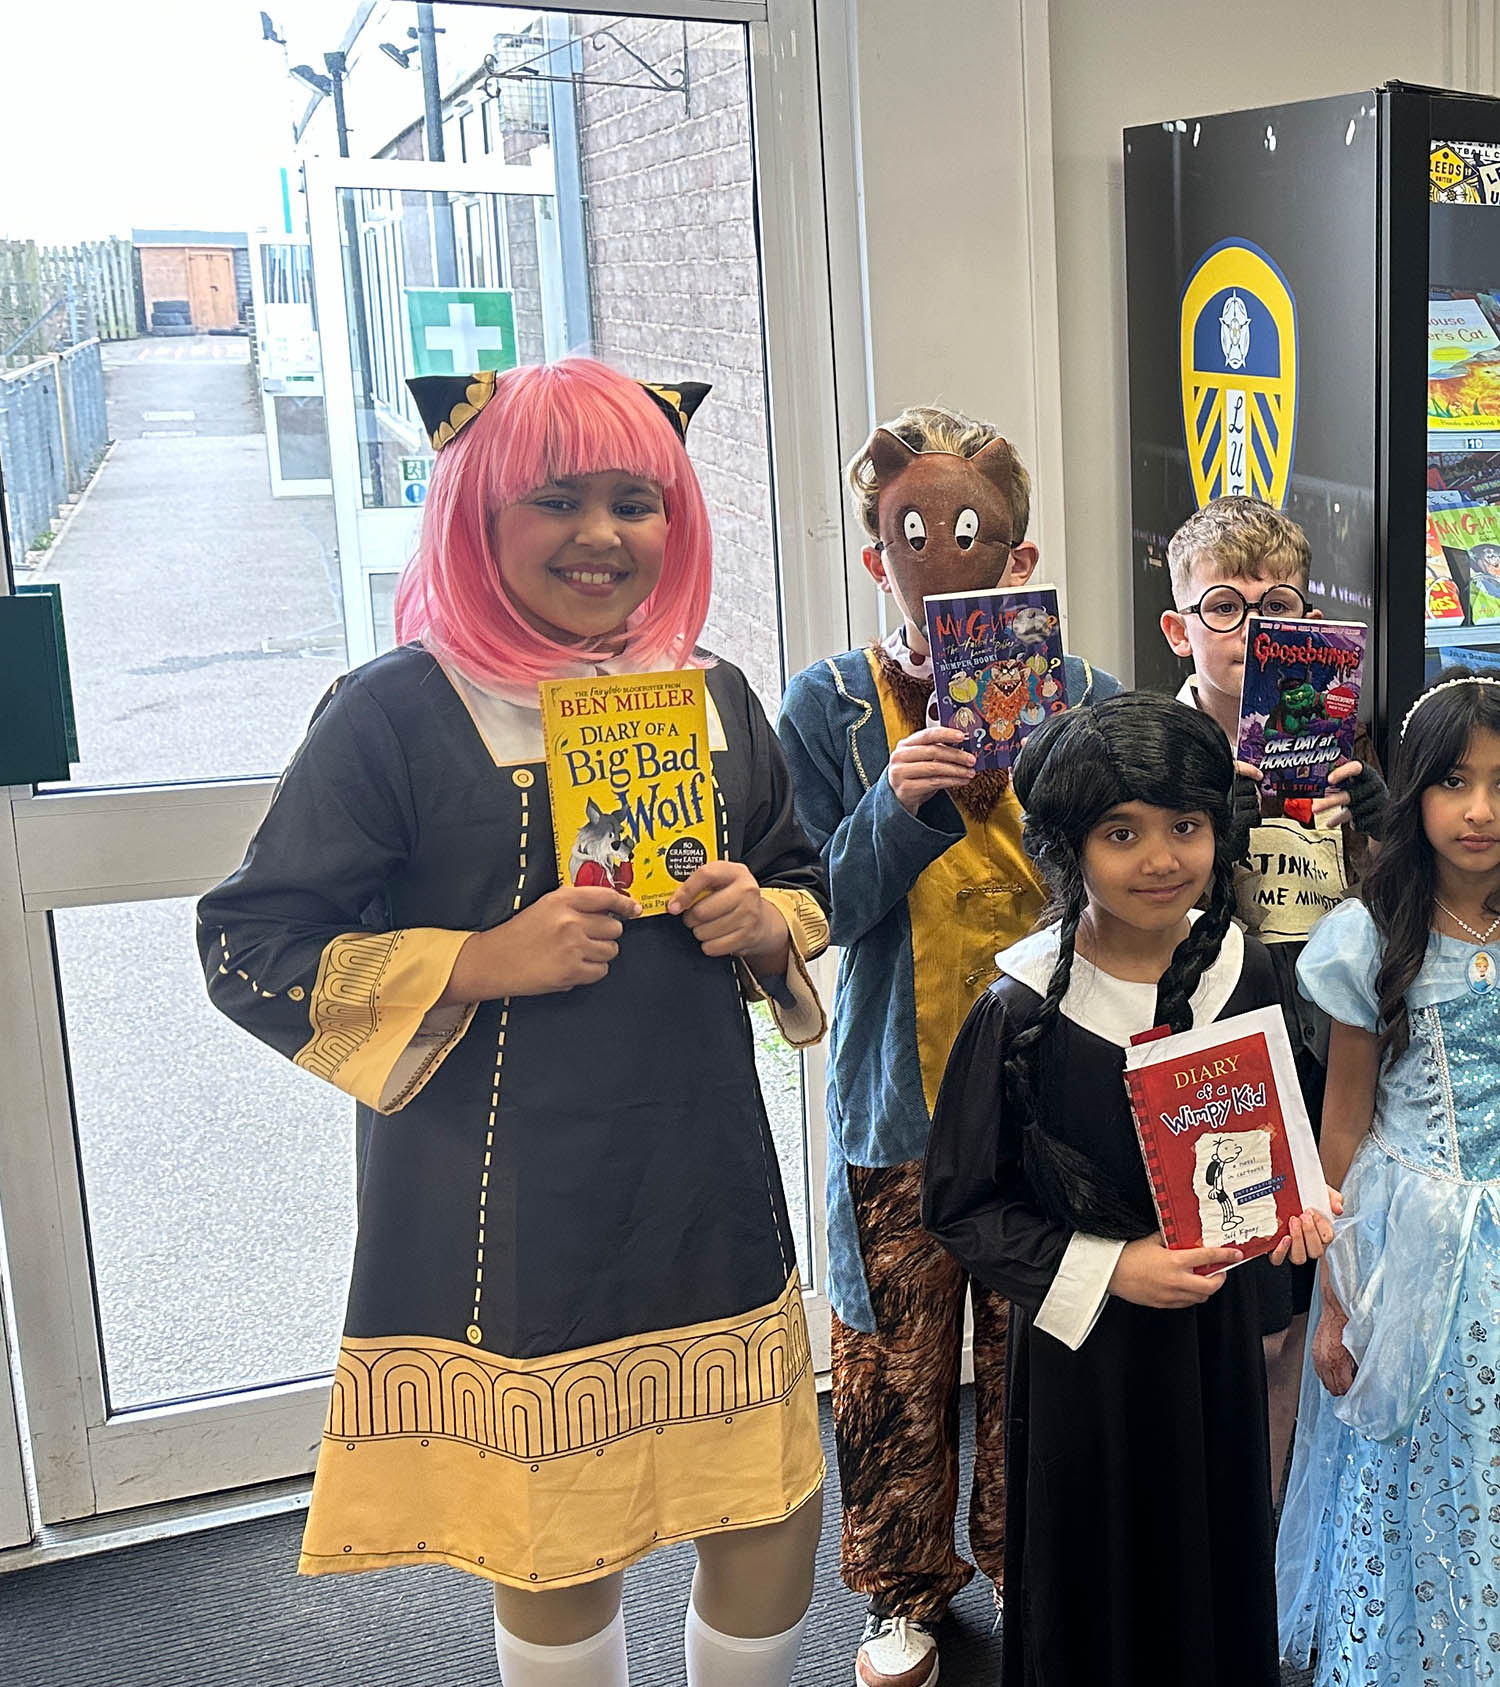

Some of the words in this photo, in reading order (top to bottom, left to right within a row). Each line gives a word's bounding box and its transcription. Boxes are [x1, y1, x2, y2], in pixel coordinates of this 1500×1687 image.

[1430, 161, 1462, 176] EEDS
[1459, 328, 1488, 342] Cat
[1435, 519, 1460, 545] Mr
[1461, 513, 1497, 535] Gum
[935, 613, 963, 646] Mr
[966, 609, 1017, 641] Gum
[940, 659, 973, 672] BUMPER
[1254, 633, 1360, 678] Goosebumps
[560, 696, 607, 718] BEN
[614, 688, 696, 712] MILLER
[579, 720, 640, 746] DIARY
[645, 722, 666, 736] OF
[667, 722, 680, 736] A
[1265, 738, 1294, 754] ONE
[1294, 737, 1317, 752] DAY
[1321, 735, 1334, 747] at
[564, 747, 632, 789] Big
[632, 733, 700, 780] Bad
[1259, 748, 1341, 770] HORRORLAND
[1293, 783, 1319, 791] STINE
[612, 771, 705, 843] Wolf
[1173, 1054, 1241, 1089] DIARY
[1197, 1083, 1213, 1100] of
[1216, 1084, 1228, 1096] a
[1160, 1099, 1231, 1136] Wimpy
[1231, 1082, 1266, 1114] Kid
